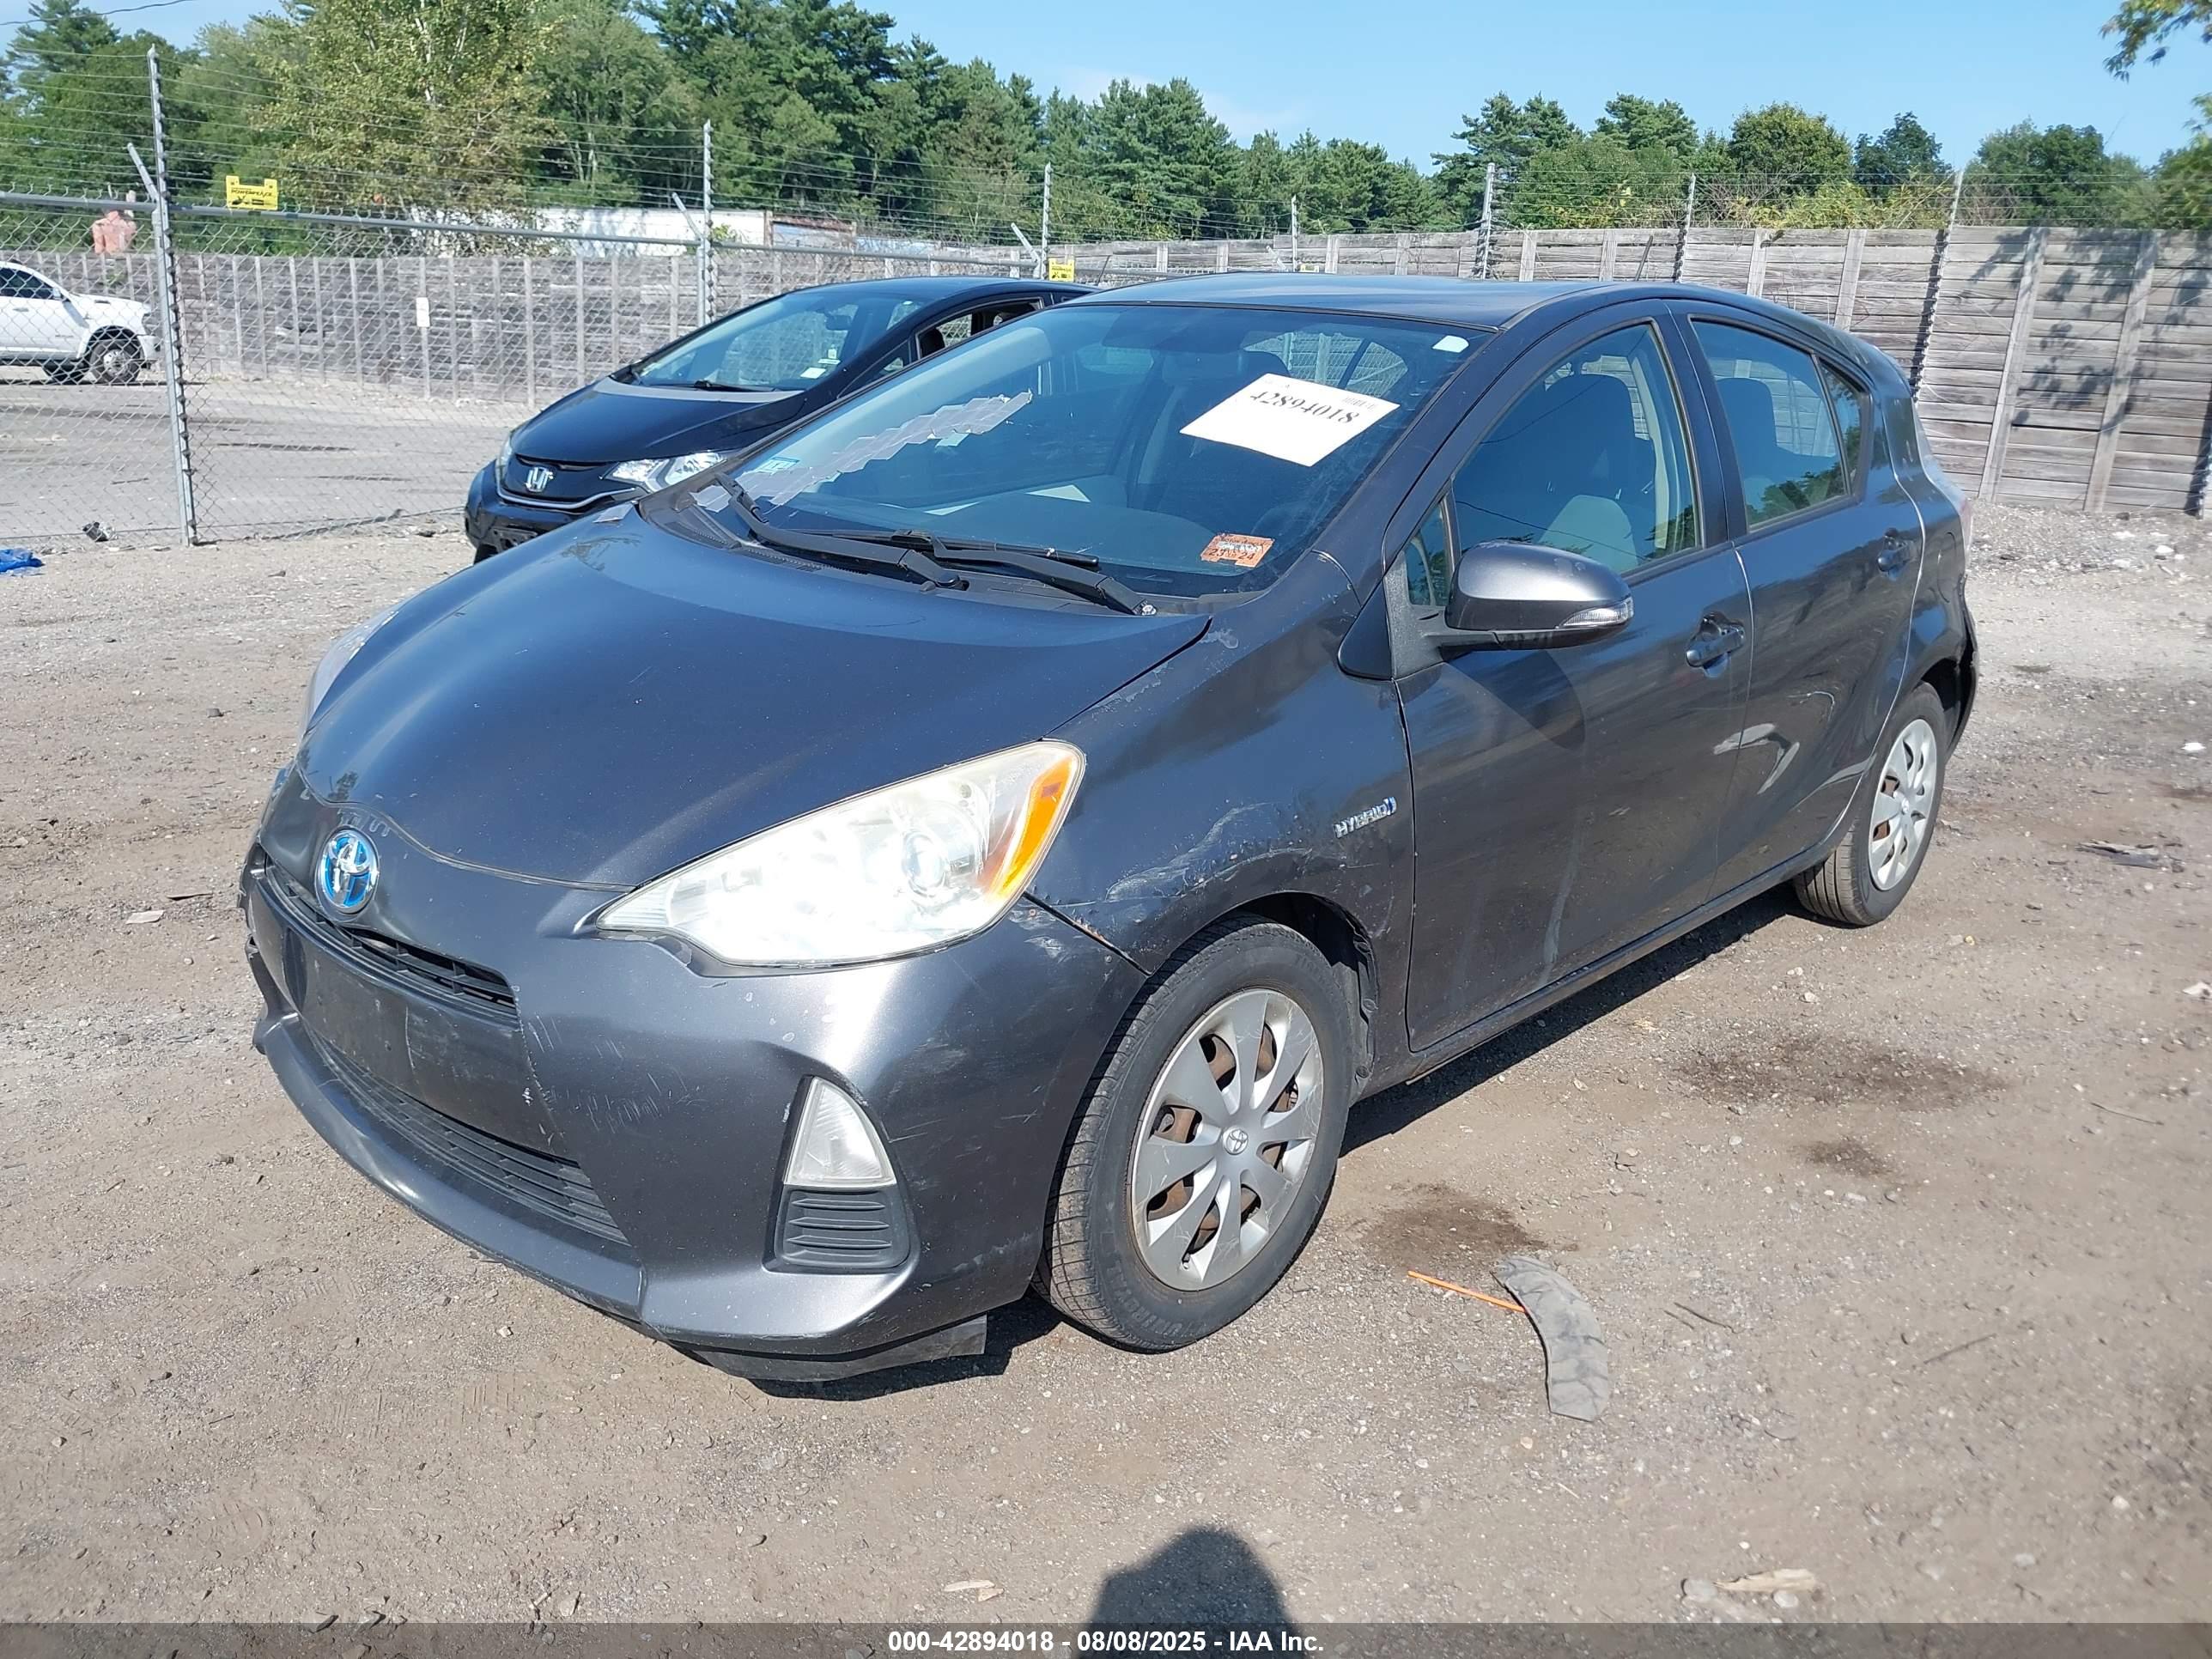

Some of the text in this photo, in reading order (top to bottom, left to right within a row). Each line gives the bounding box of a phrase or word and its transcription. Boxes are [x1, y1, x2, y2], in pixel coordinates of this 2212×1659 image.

[1250, 391, 1359, 423] 42894018
[1208, 548, 1225, 557] 23
[1237, 551, 1255, 561] 24
[1334, 803, 1388, 838] HYBRID
